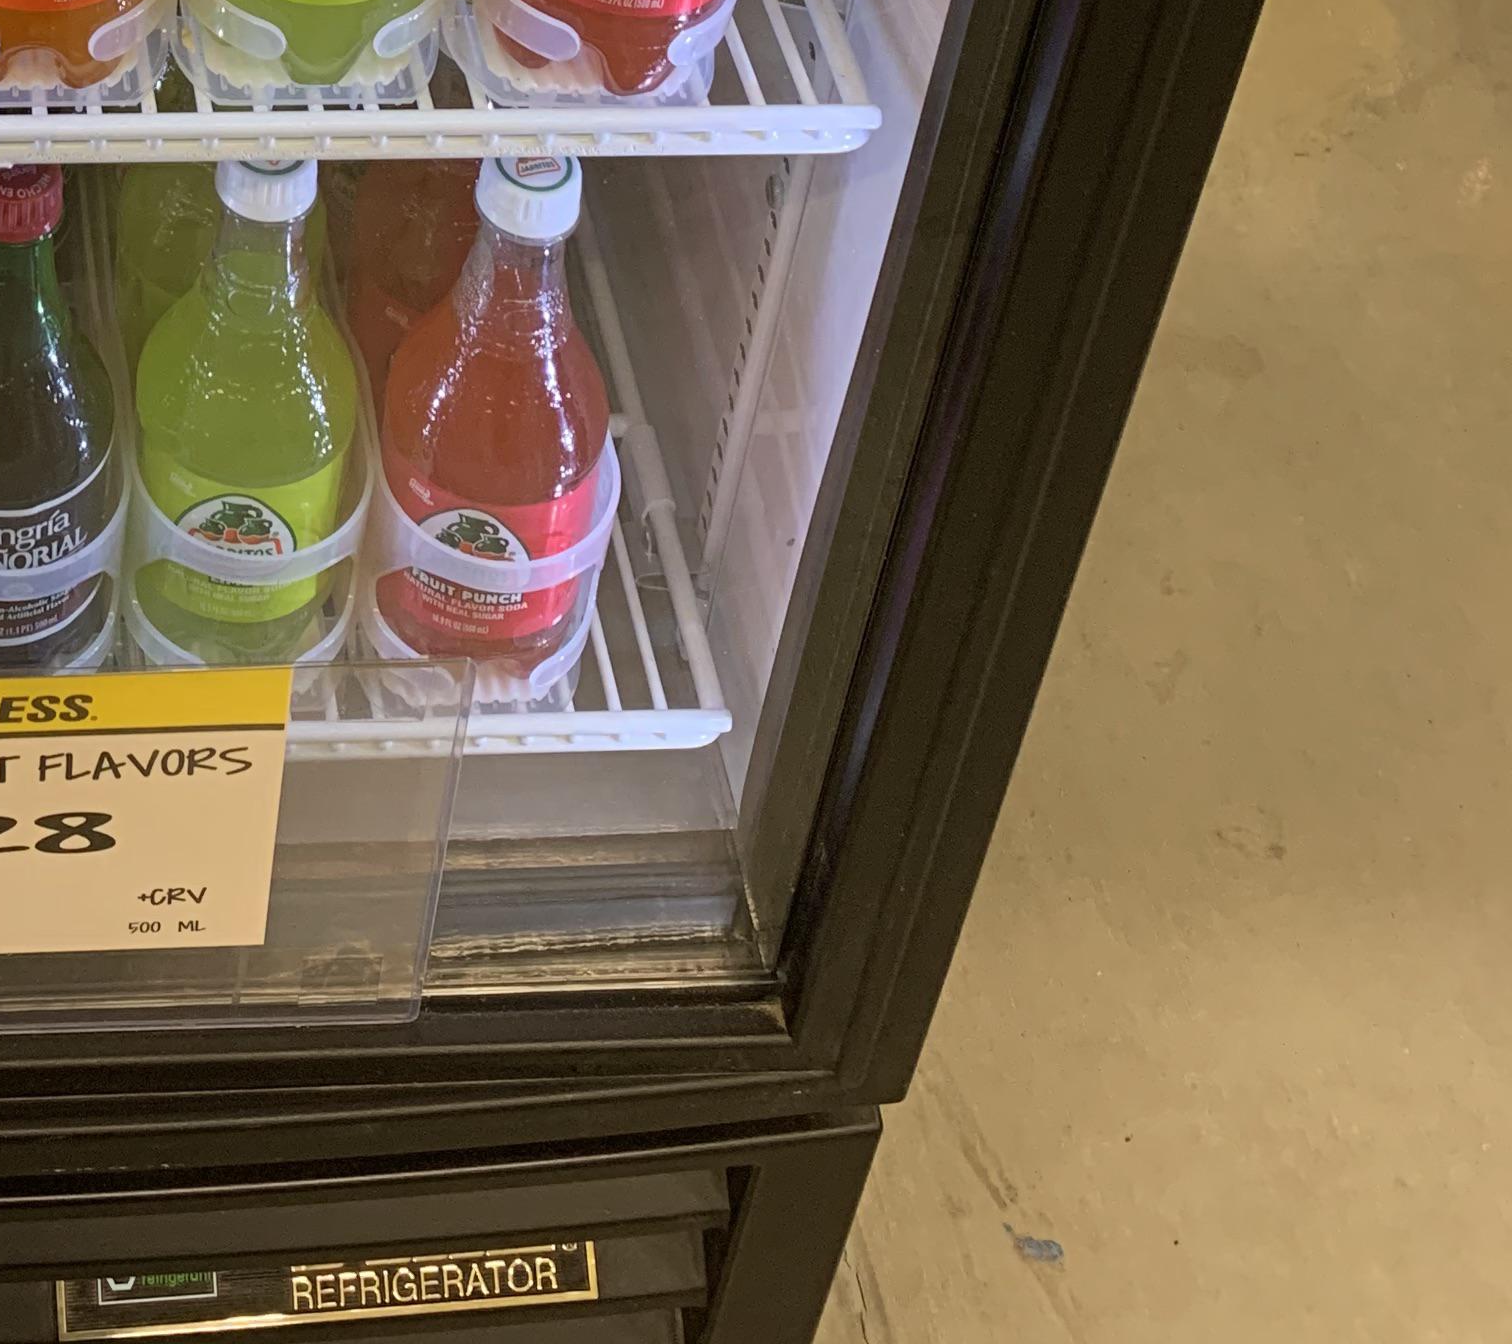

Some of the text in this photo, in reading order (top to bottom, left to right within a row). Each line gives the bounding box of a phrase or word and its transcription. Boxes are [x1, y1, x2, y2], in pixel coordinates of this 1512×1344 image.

[411, 566, 522, 604] FRUIT PUNCH
[421, 593, 504, 621] WITH REAL SUGAR
[451, 598, 494, 612] FLAVOR
[498, 601, 528, 613] SODA
[37, 746, 254, 783] FLAVORS
[136, 886, 208, 907] +CRV
[128, 919, 206, 934] 500 ML
[291, 1257, 558, 1311] REFRIGERATOR
